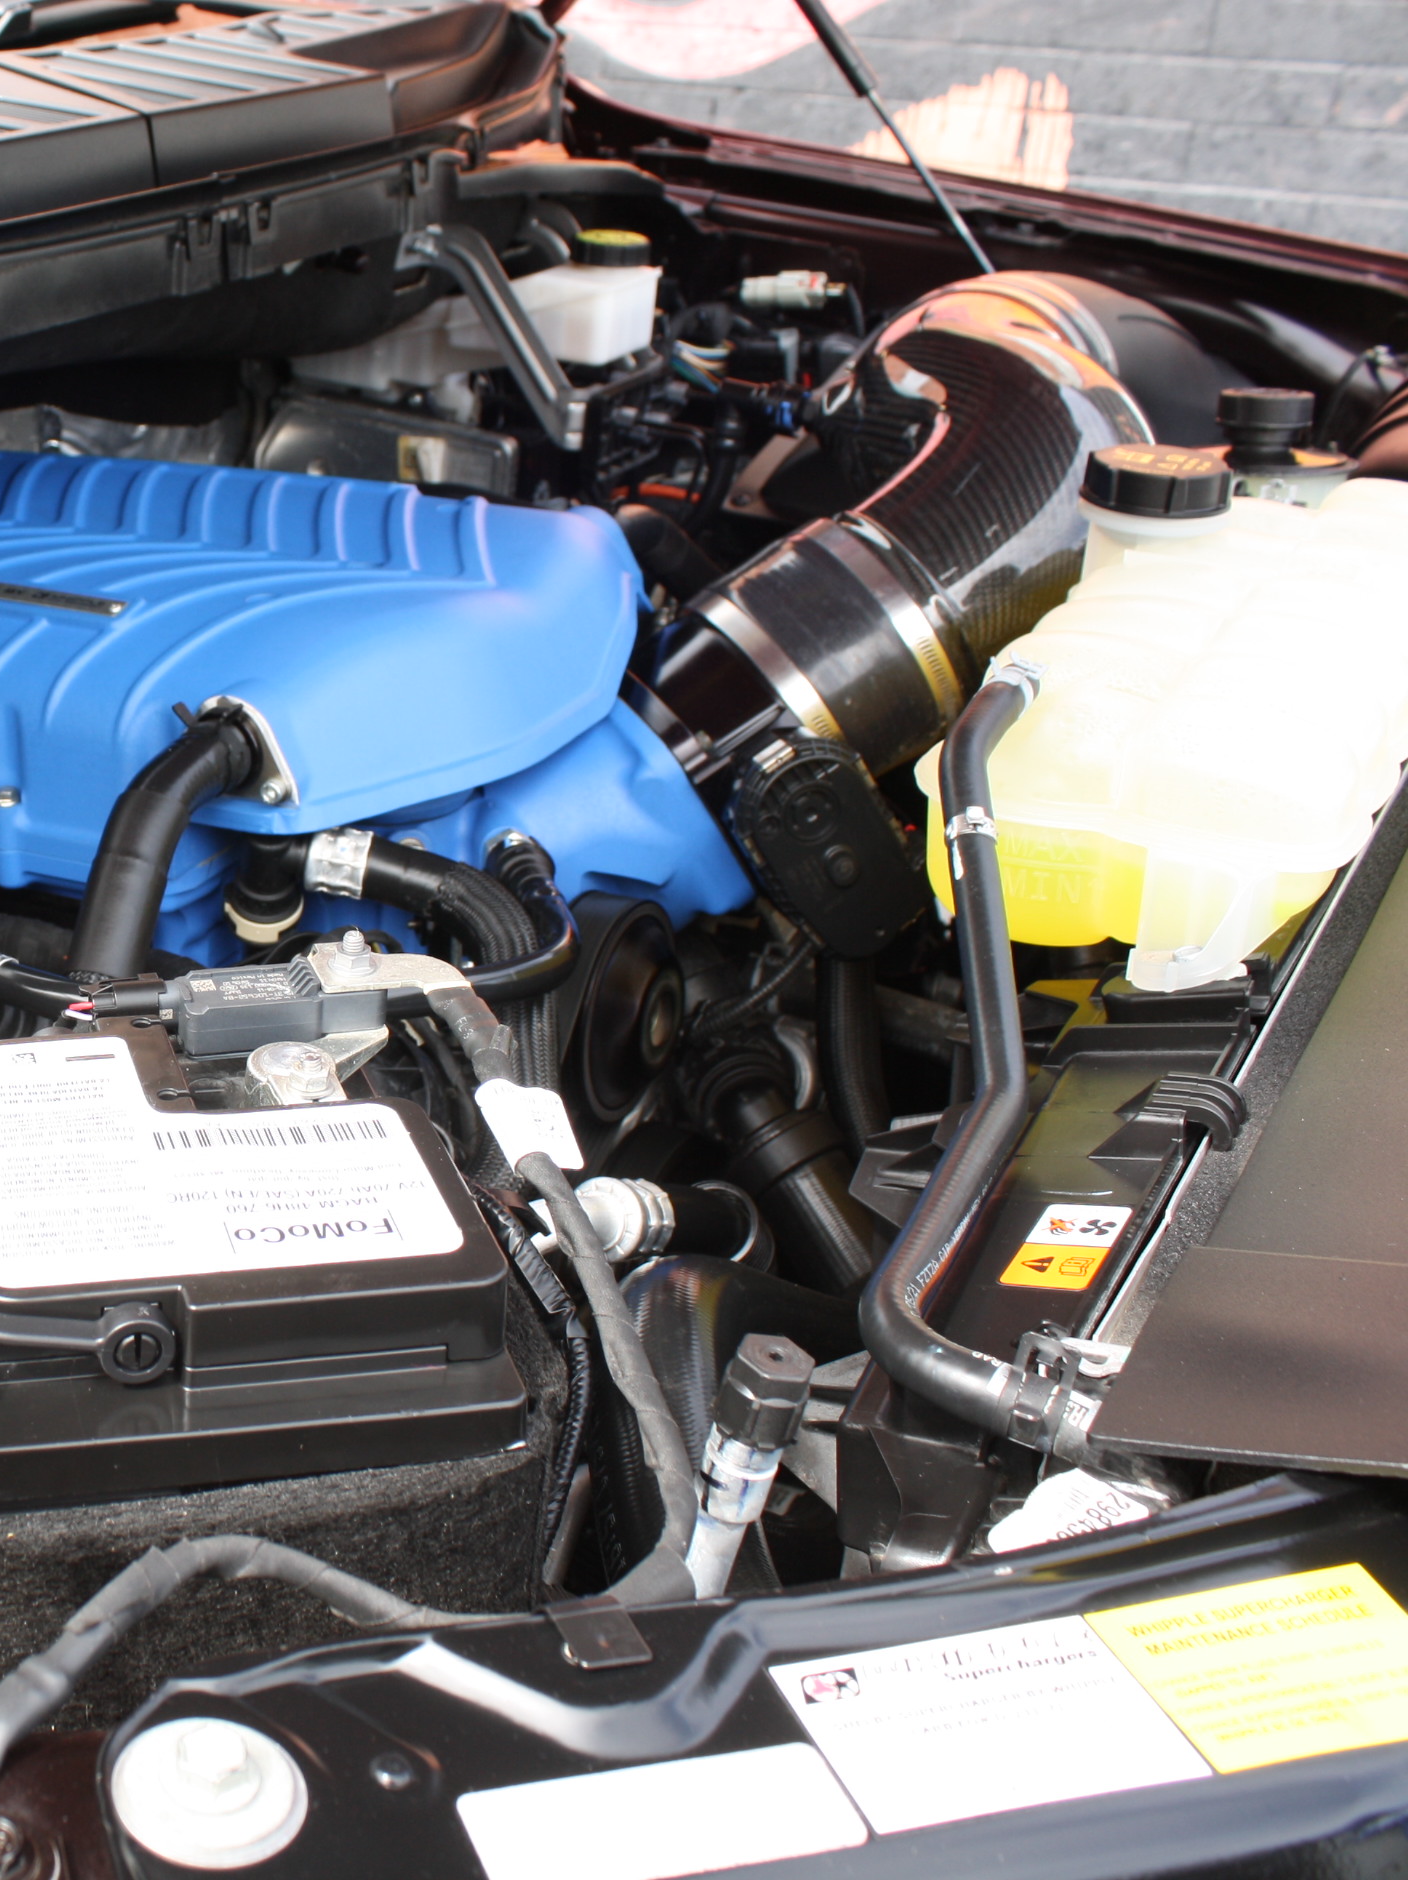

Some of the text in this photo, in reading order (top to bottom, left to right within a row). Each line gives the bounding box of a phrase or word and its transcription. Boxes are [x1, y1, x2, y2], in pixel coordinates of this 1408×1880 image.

[1005, 827, 1085, 862] MAX
[1003, 866, 1081, 903] MIN
[234, 1217, 394, 1243] FoMoCo
[1124, 1582, 1357, 1639] WHIPPLE SUPERCHARGER
[1143, 1619, 1276, 1657] MAINTENANCE
[1276, 1601, 1375, 1634] SCHEDULE
